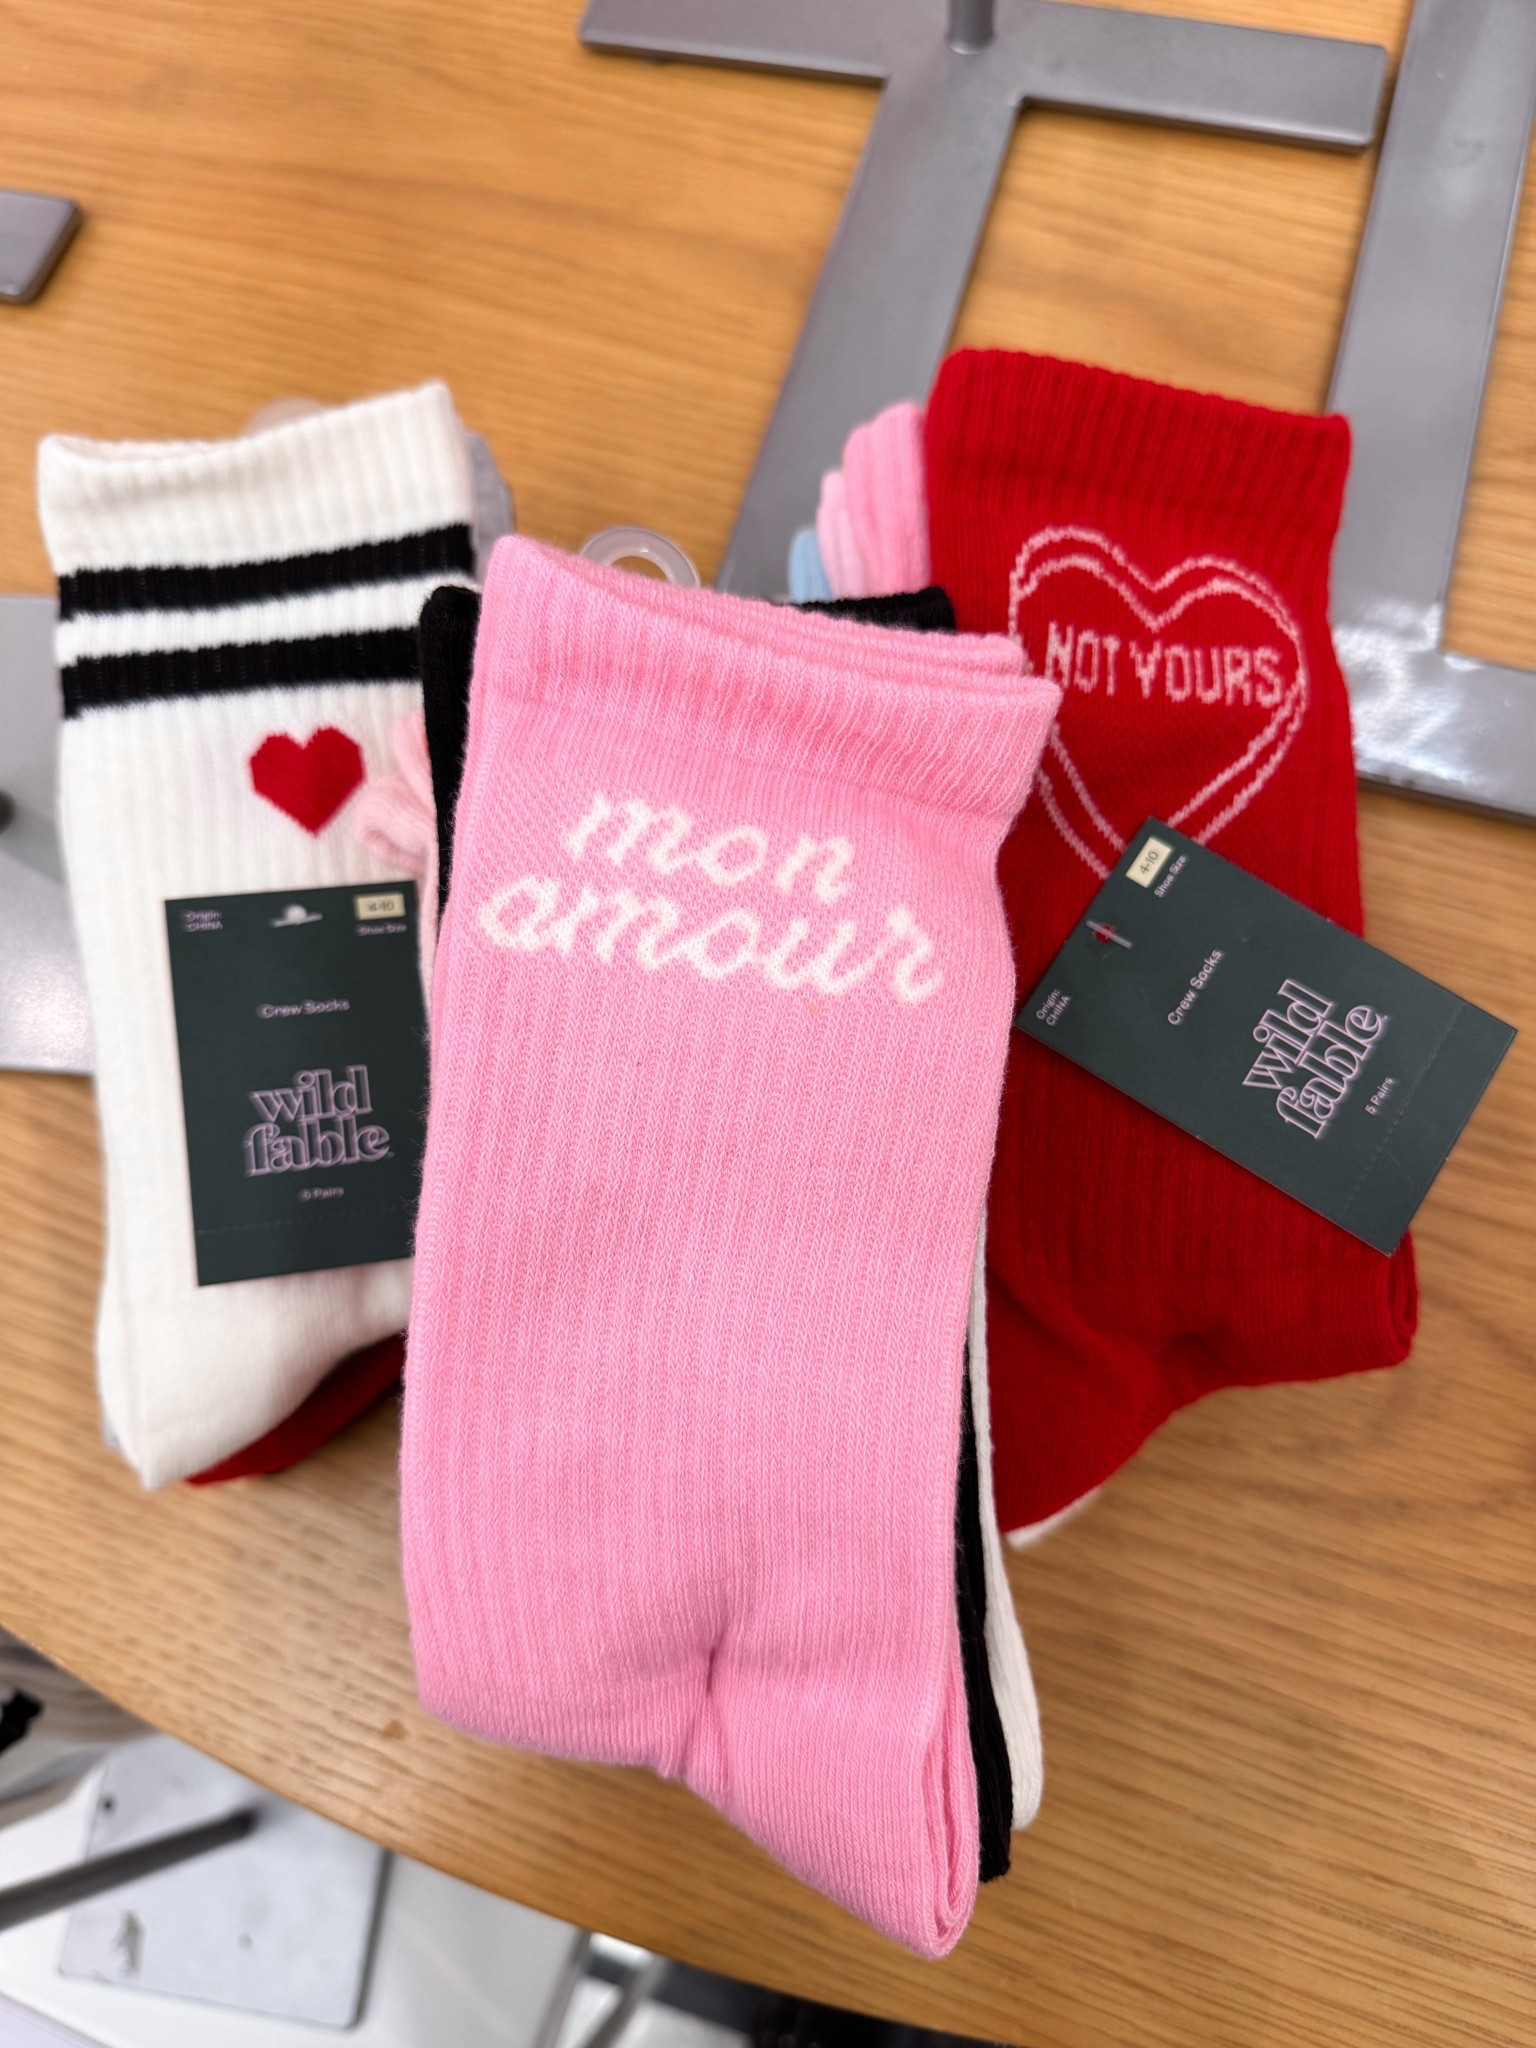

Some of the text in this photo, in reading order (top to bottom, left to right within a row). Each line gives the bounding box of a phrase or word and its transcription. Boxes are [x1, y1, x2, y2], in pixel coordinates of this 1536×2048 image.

[1045, 620, 1285, 709] NOT YOURS
[565, 791, 856, 904] mon
[1139, 850, 1159, 876] 4-10
[1153, 855, 1187, 898] Shoe Size
[477, 873, 945, 1004] amour
[257, 997, 351, 1020] Crew Socks
[1036, 989, 1060, 1020] Origin:
[1046, 995, 1071, 1026] CHINA
[1167, 949, 1223, 1026] Crew Socks
[1241, 978, 1334, 1090] wild
[248, 1064, 373, 1122] wild
[1276, 1004, 1383, 1140] fable
[1370, 1077, 1394, 1107] Pairs
[243, 1114, 391, 1177] fable
